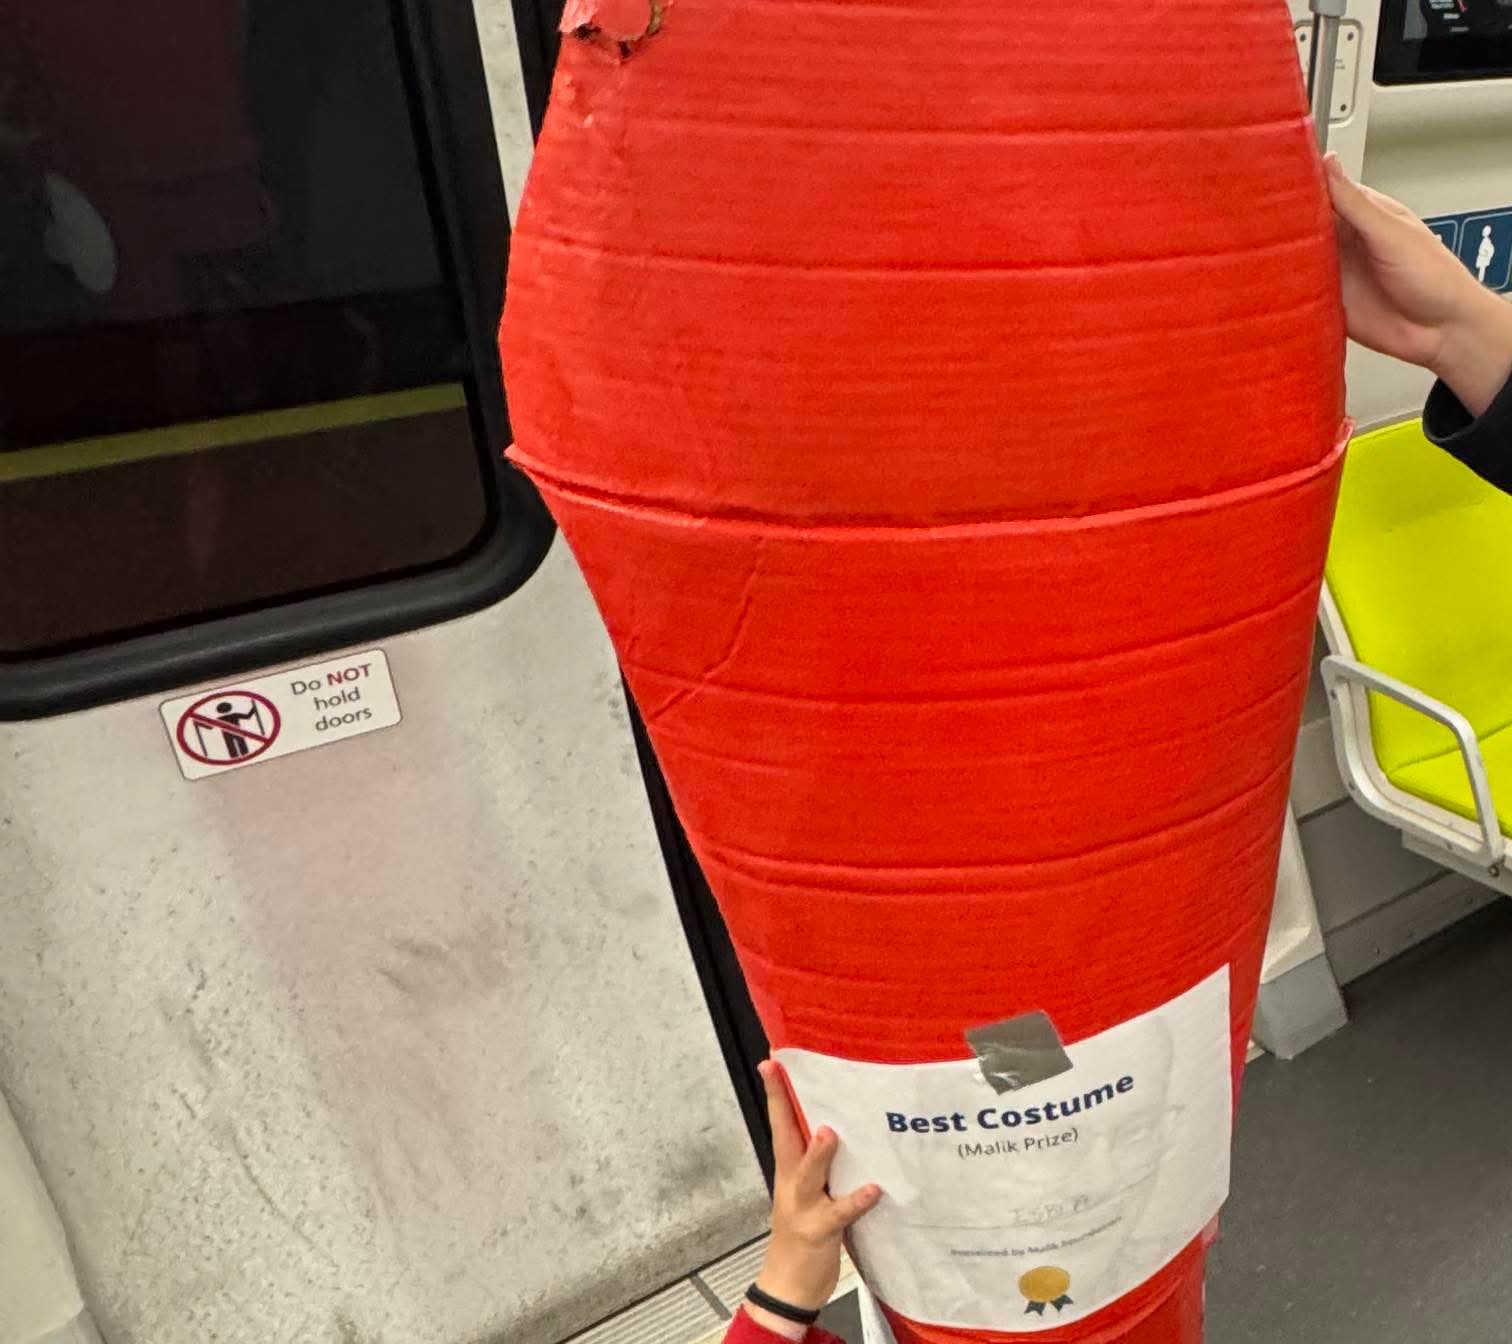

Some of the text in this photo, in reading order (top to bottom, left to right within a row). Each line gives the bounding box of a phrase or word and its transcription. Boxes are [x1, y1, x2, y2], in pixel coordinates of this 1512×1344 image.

[290, 663, 373, 695] Do NOT
[313, 686, 361, 710] hold
[315, 707, 373, 731] doors
[886, 1075, 1135, 1133] Best Costume
[957, 1127, 1079, 1160] (Malik Prize)
